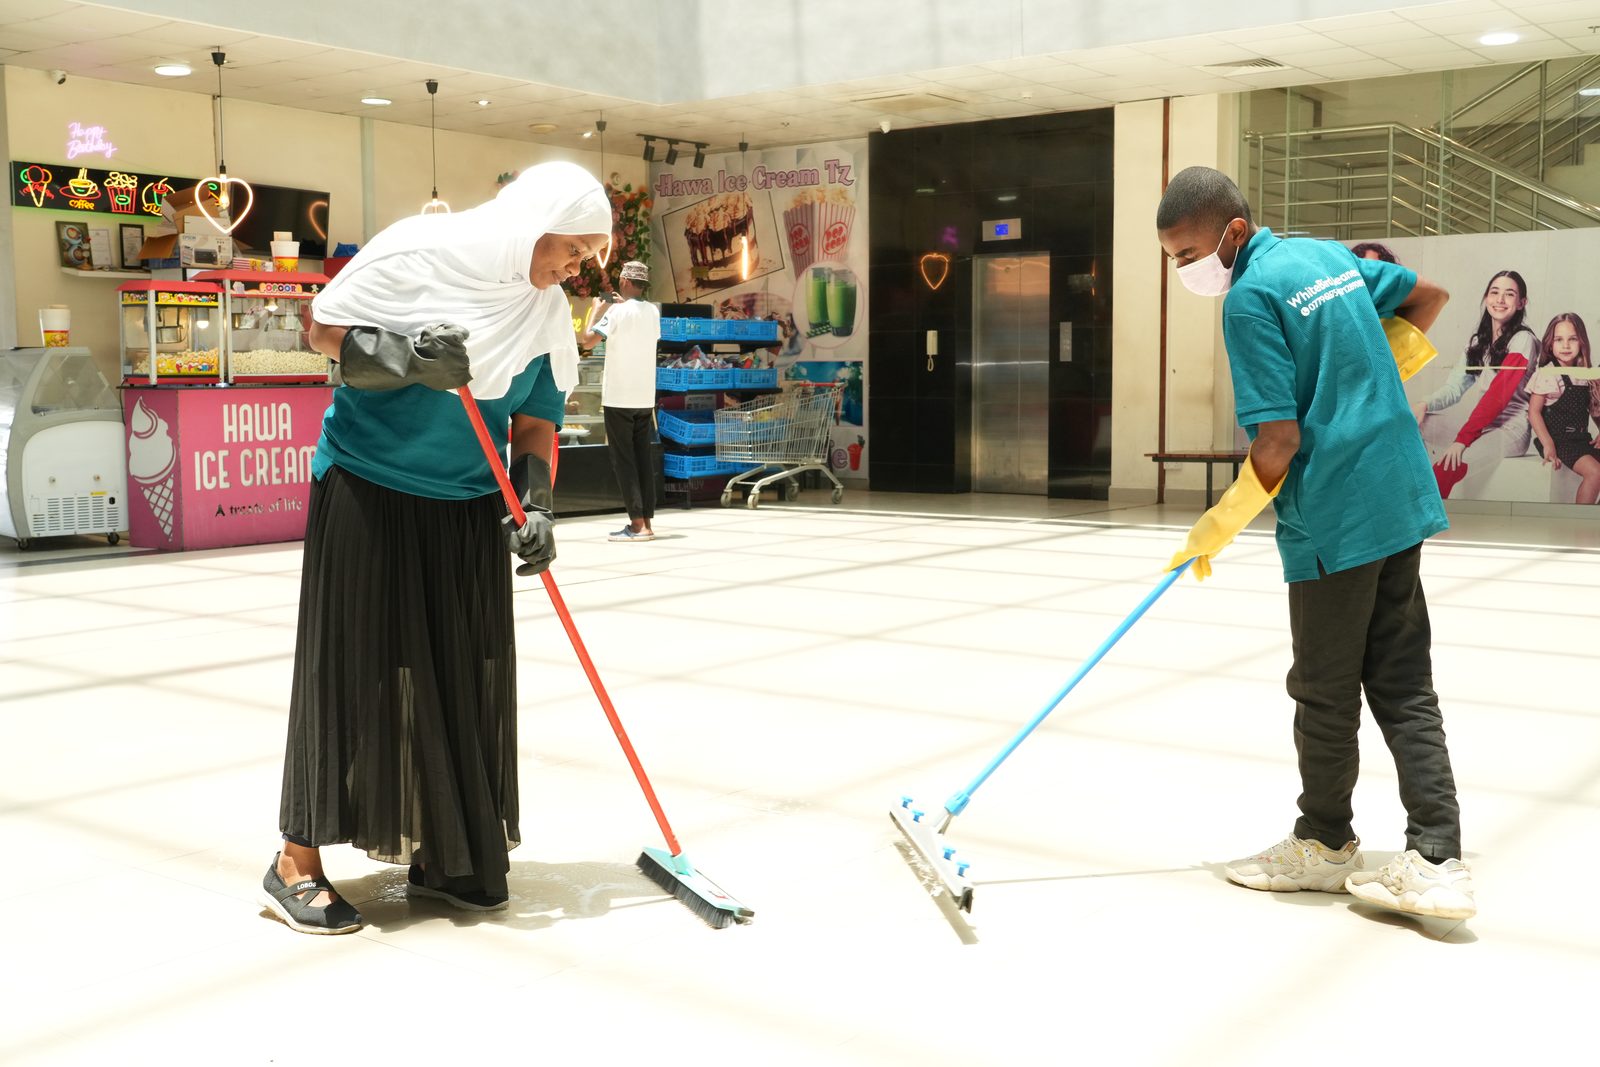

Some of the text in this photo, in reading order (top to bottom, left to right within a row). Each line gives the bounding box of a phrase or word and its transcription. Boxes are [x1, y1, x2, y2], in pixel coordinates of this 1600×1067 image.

[68, 122, 108, 146] Happy
[655, 158, 855, 197] Hawa Ice Cream Tz
[223, 402, 292, 443] HAWA
[194, 445, 318, 491] ICE CREAM
[215, 504, 226, 517] A
[268, 498, 282, 513] of
[284, 498, 303, 512] life
